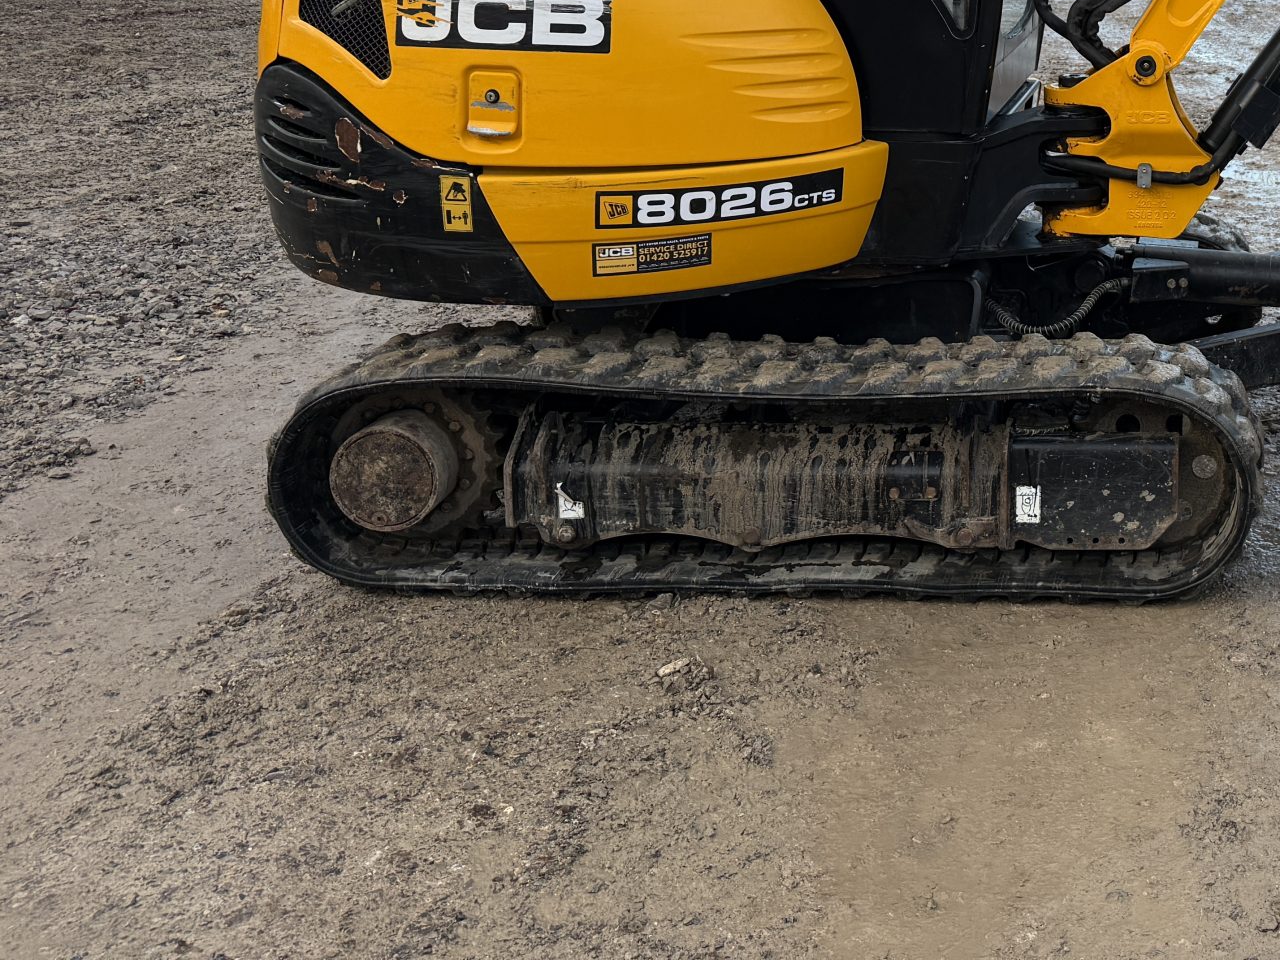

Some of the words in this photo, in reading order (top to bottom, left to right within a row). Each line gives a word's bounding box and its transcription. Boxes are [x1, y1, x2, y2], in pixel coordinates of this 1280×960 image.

[606, 202, 629, 218] JCB
[599, 247, 634, 258] JCB
[638, 244, 675, 255] SERVICE
[676, 240, 709, 251] DIRECT
[638, 252, 670, 263] 01420
[672, 246, 709, 259] 525917
